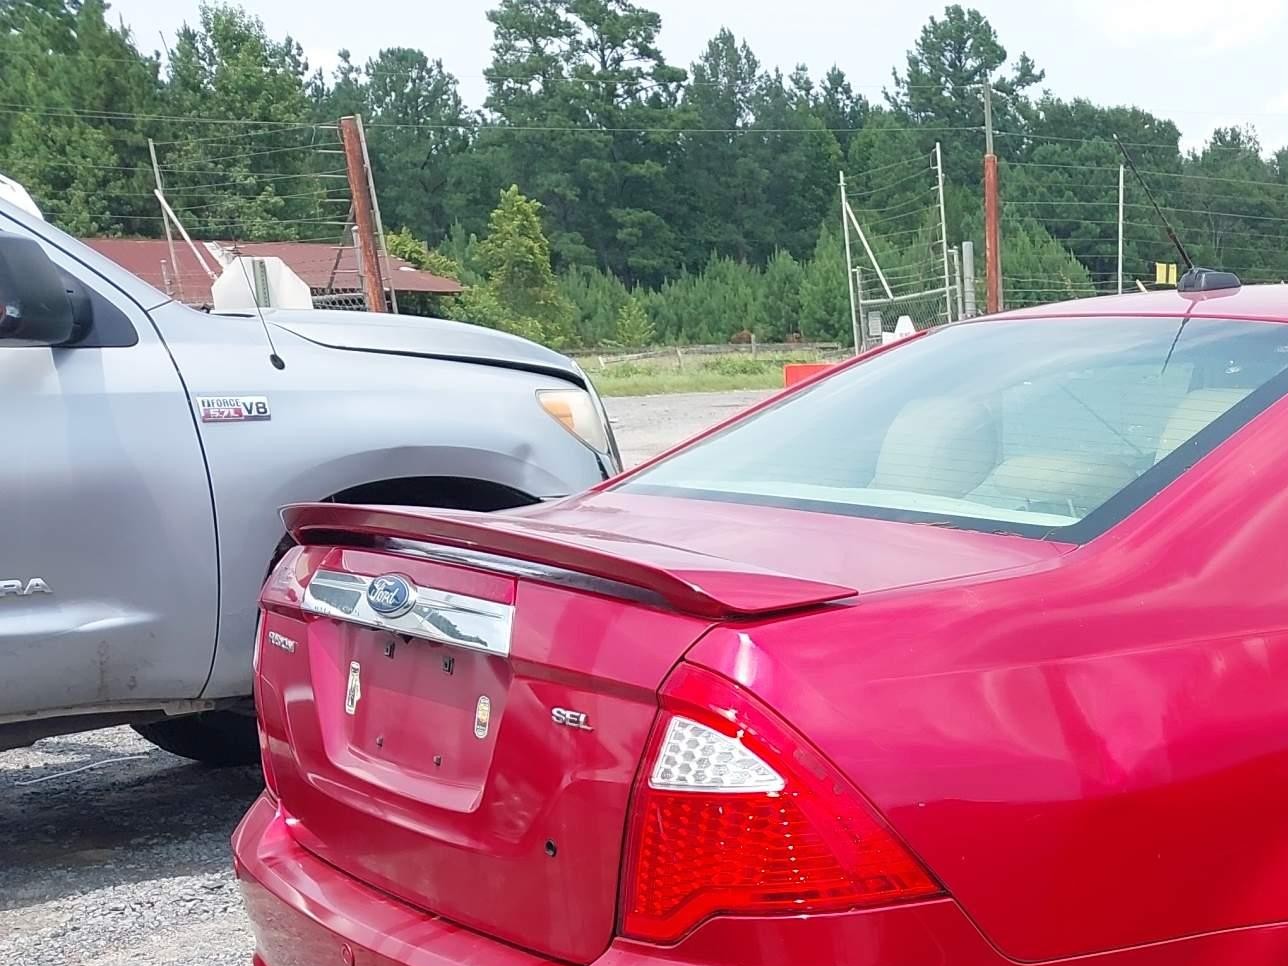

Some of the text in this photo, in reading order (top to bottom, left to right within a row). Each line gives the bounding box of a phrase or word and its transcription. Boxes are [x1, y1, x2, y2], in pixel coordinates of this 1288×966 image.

[242, 401, 268, 415] V8
[370, 578, 400, 604] Ford
[551, 707, 593, 731] SEL
